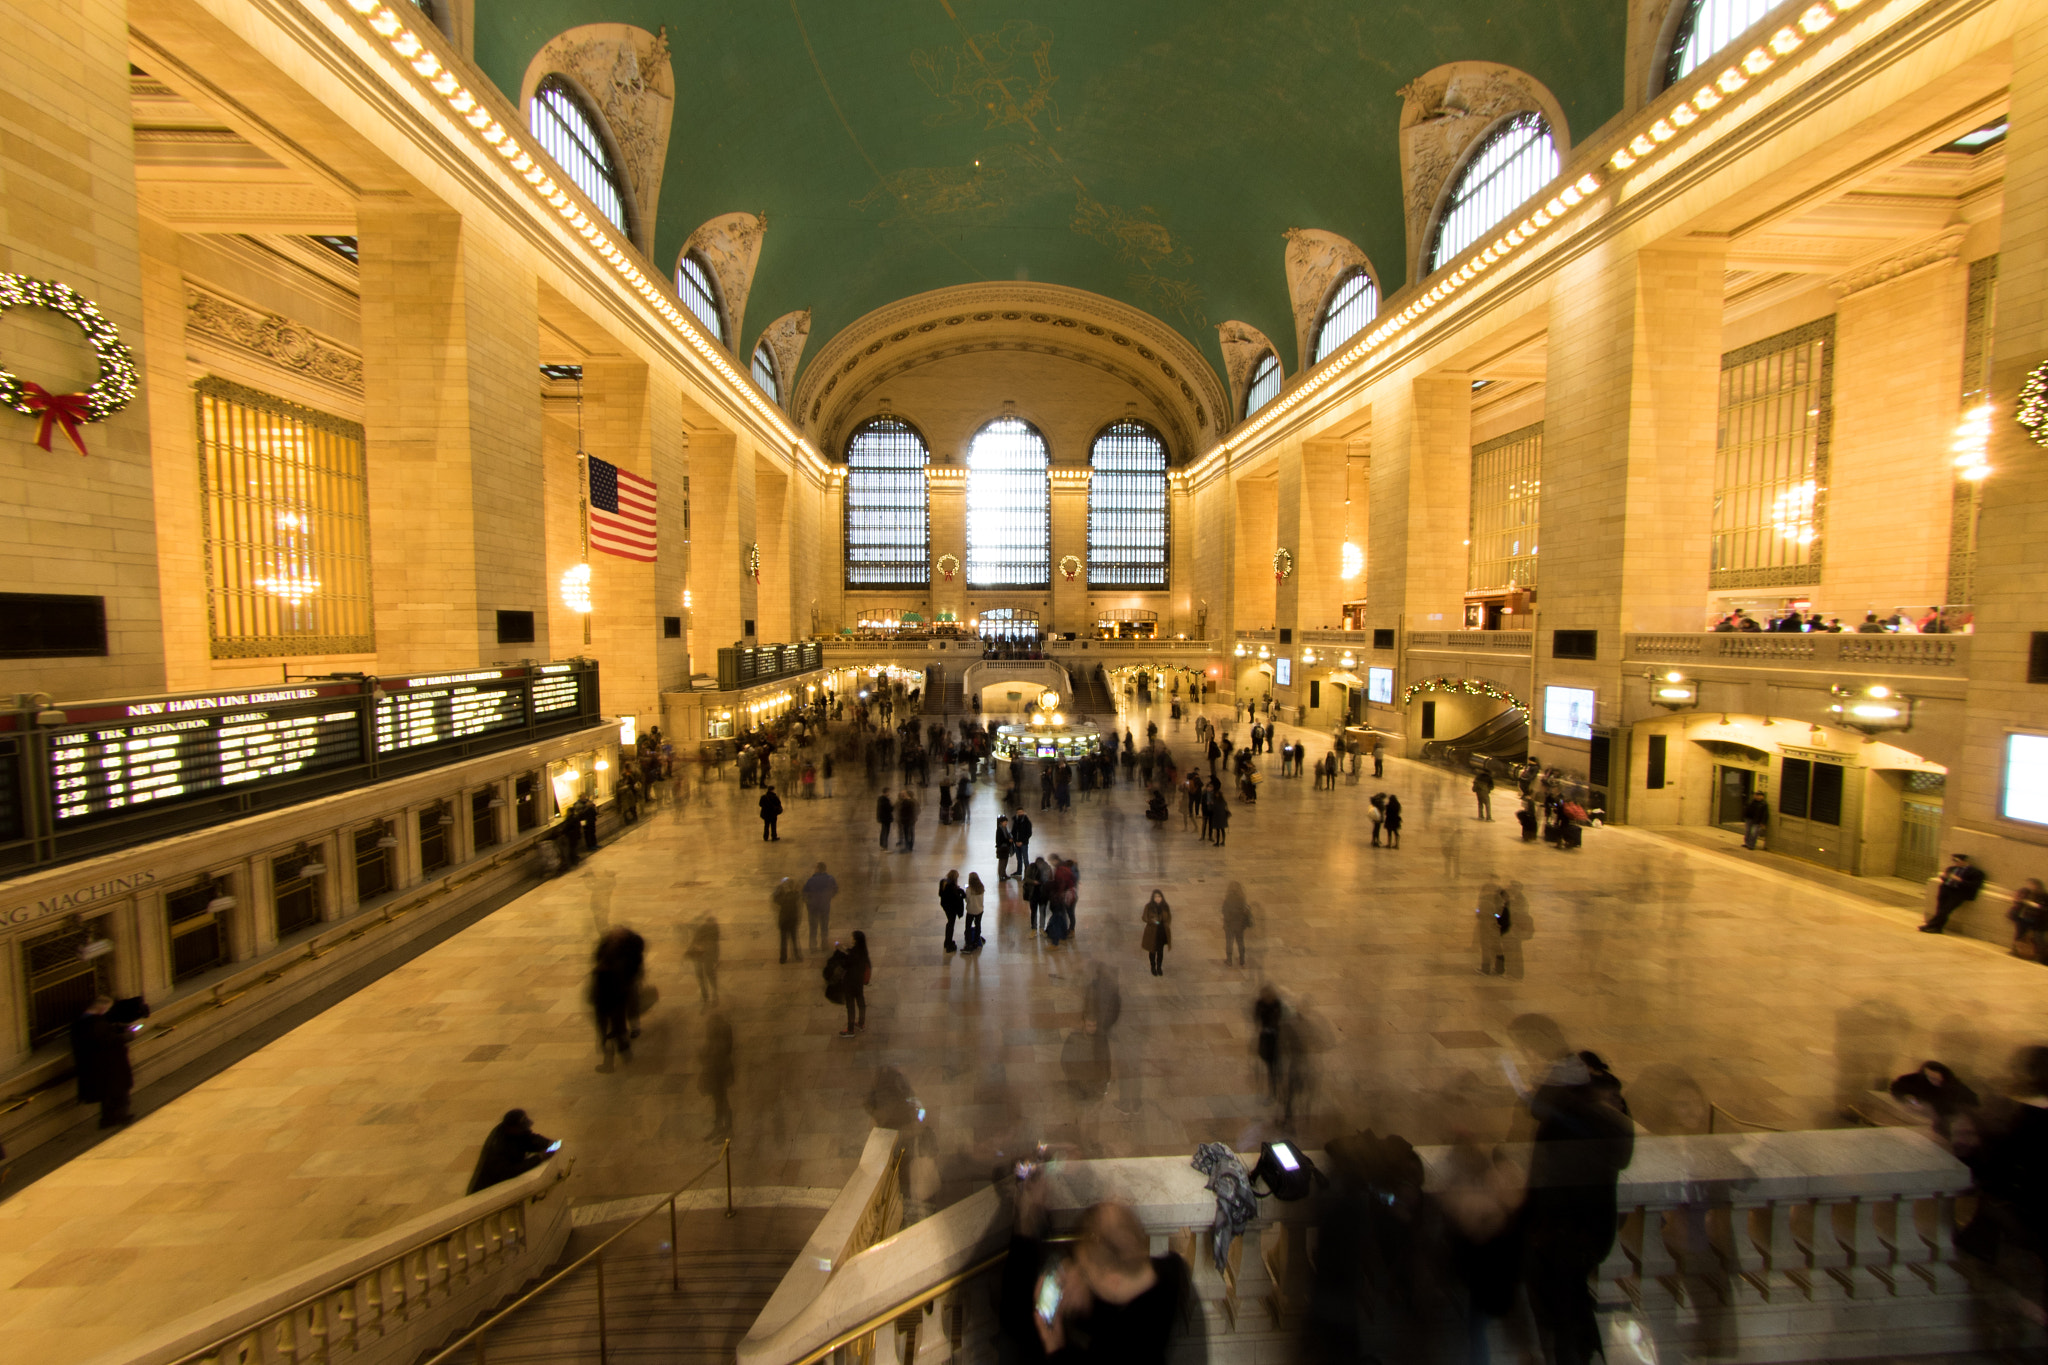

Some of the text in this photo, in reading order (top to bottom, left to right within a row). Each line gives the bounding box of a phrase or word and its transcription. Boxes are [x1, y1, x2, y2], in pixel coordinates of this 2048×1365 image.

[408, 671, 502, 687] NEW HAVEN LINE DEPARTURES
[128, 690, 318, 716] NEW HAVEN LINE DEPARTURES
[412, 690, 448, 700] DESTINATION
[55, 712, 268, 745] TIME TRK DESTINATION REMARKS
[109, 798, 126, 808] 24
[37, 869, 157, 917] MACHINES
